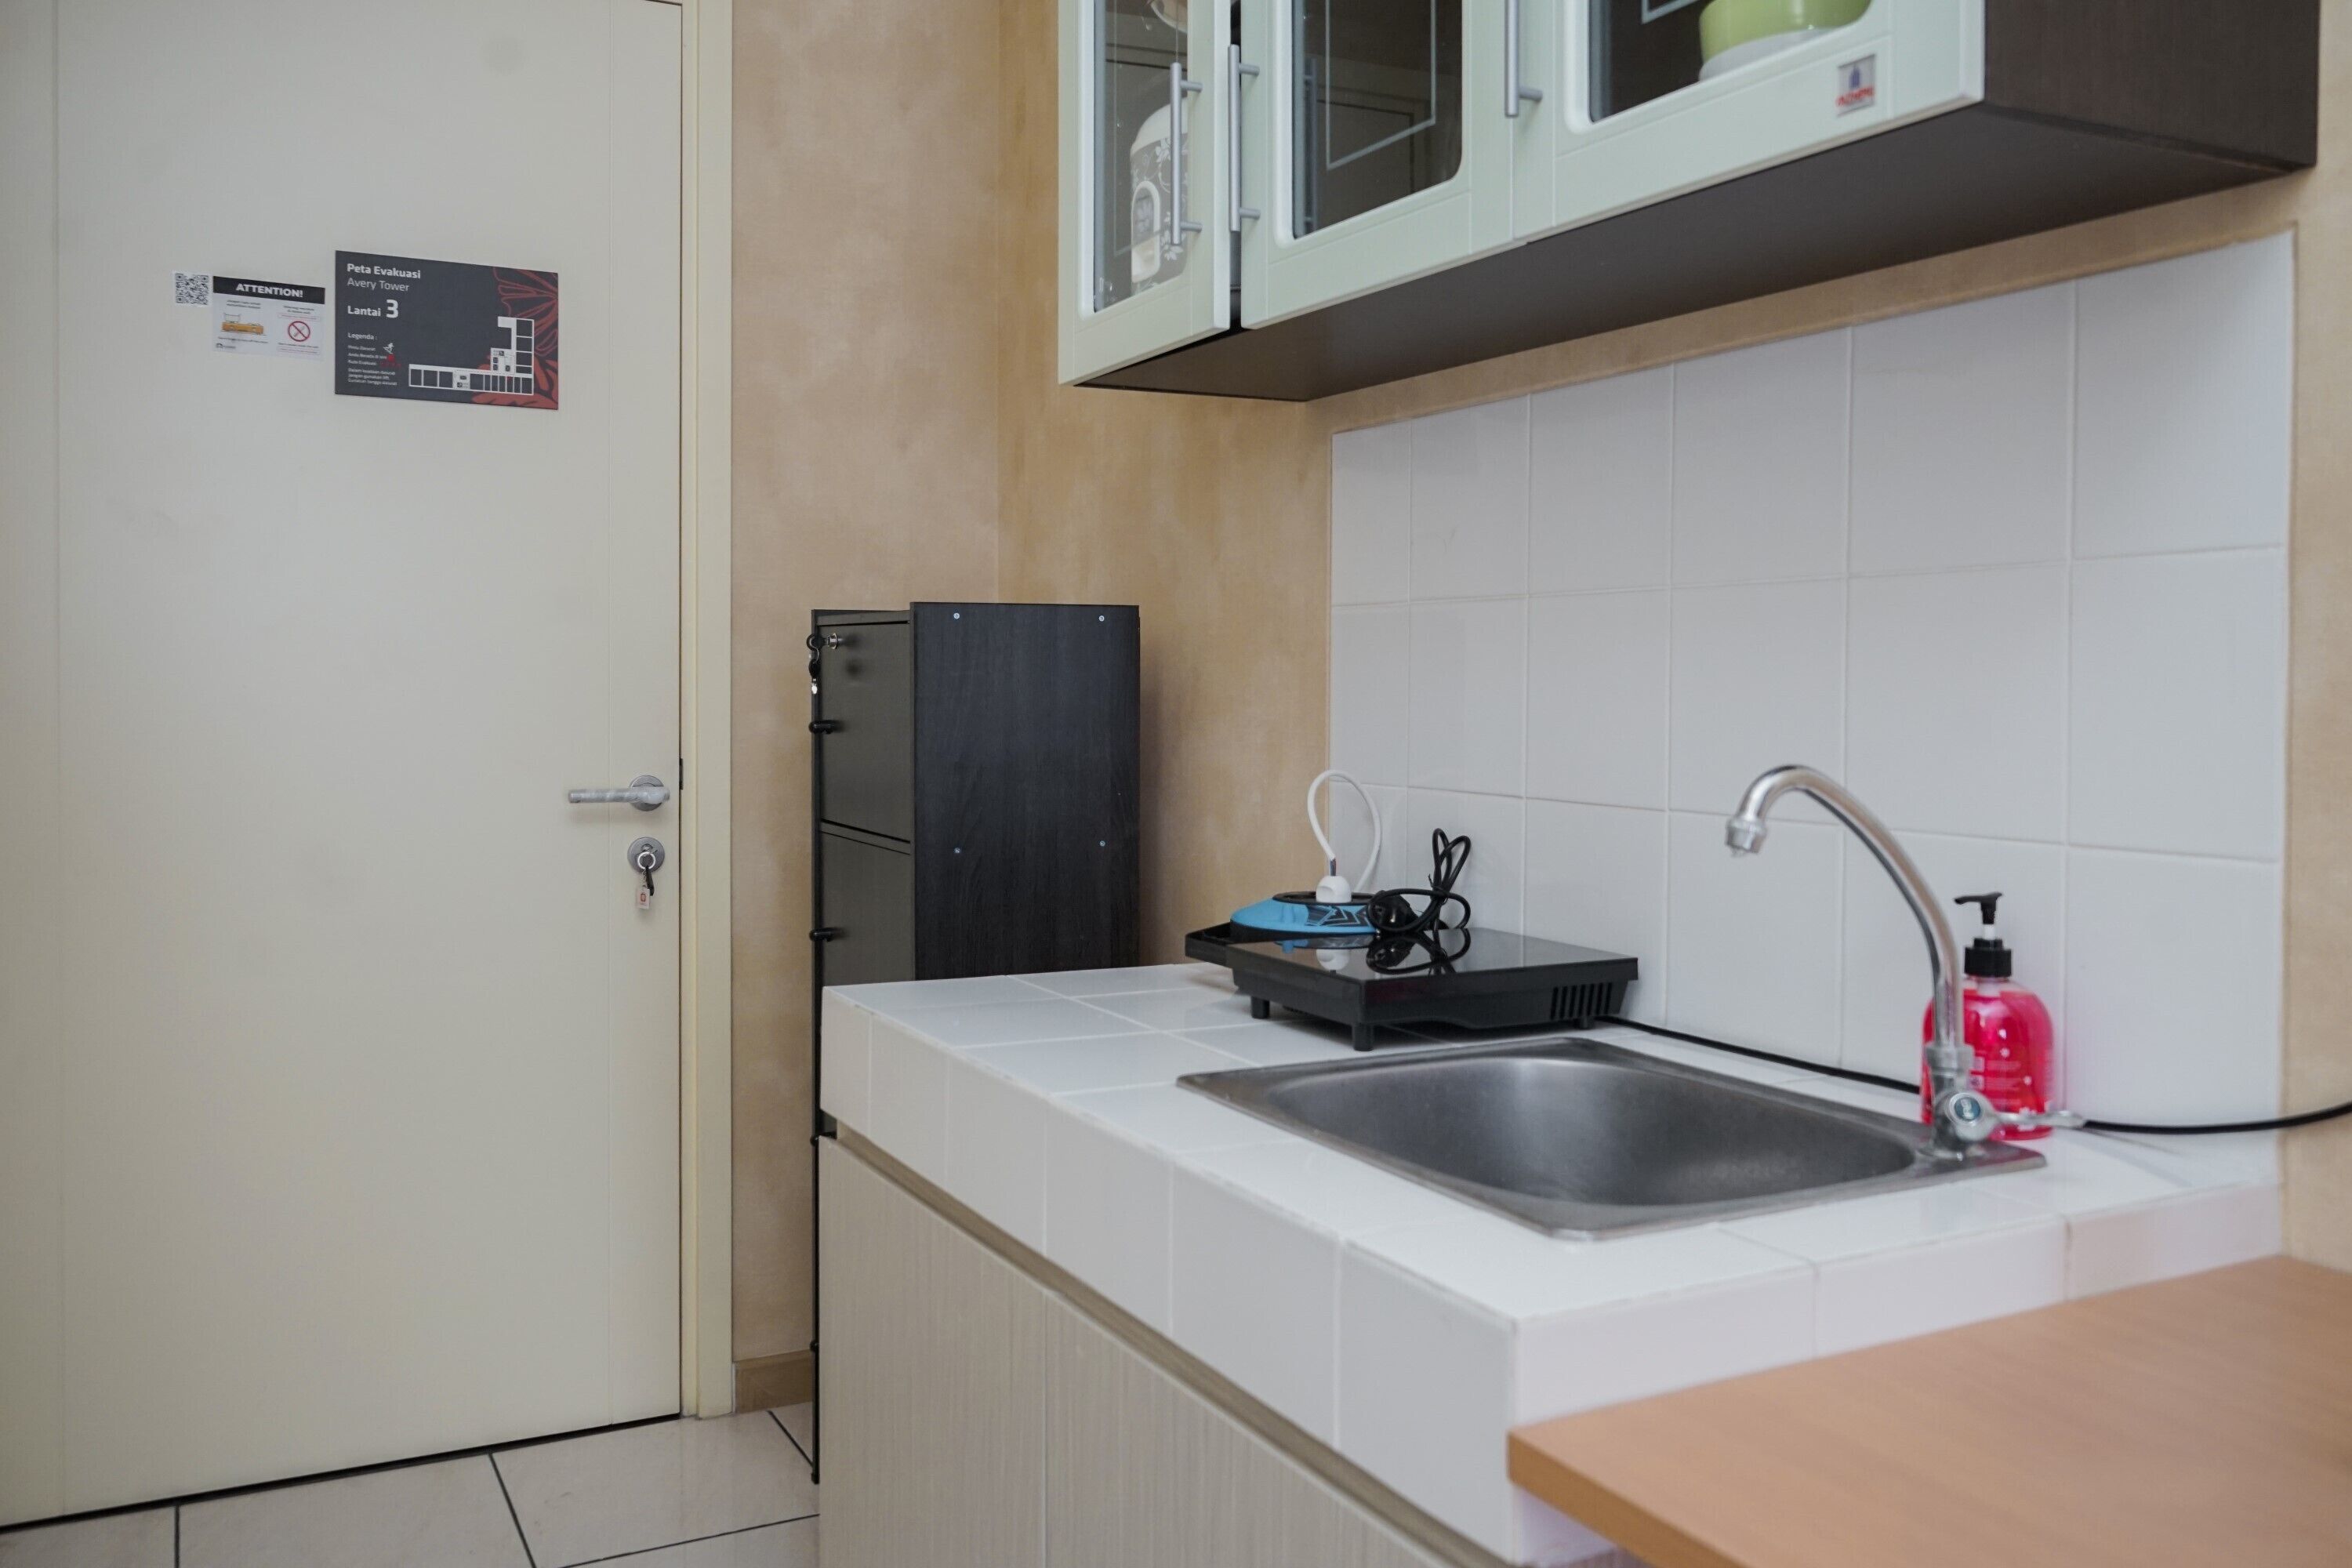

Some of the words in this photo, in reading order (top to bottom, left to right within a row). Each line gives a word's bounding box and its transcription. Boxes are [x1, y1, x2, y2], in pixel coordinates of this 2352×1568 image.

[347, 263, 372, 274] Peta
[373, 266, 421, 279] Evakuasi
[236, 283, 303, 297] ATTENTION!
[347, 278, 376, 291] Avery
[379, 280, 409, 292] Tower
[347, 305, 381, 317] Lantai
[387, 299, 399, 318] 3
